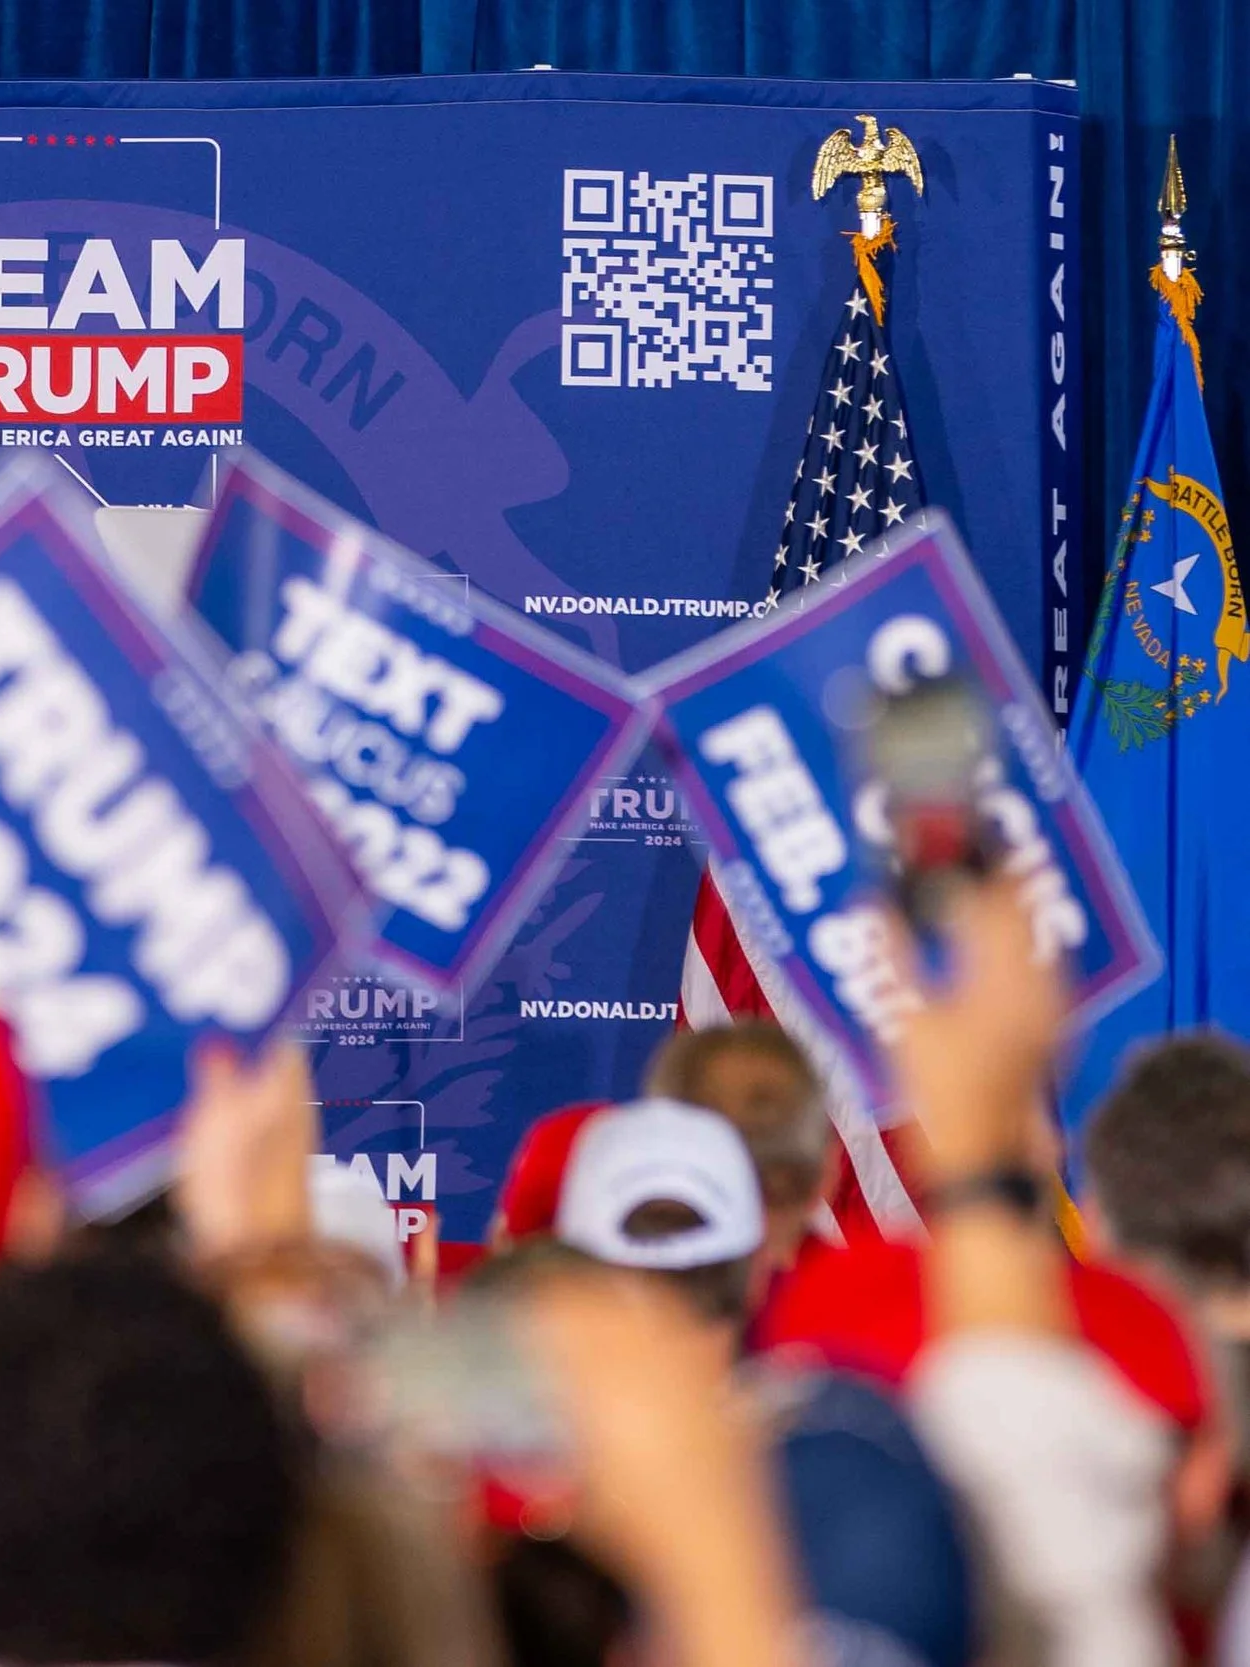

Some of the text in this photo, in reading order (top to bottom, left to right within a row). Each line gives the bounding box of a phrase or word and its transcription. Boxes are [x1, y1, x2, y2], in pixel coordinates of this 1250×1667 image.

[78, 429, 155, 447] GREAT
[161, 430, 244, 447] AGAIN!
[1171, 482, 1243, 619] BATTLE BORN
[525, 595, 768, 619] NV.DONALDJTRUMP.C
[1125, 579, 1172, 670] NEVADA
[273, 572, 507, 758] TEXT
[590, 788, 691, 820] TRU
[590, 822, 618, 831] MAKE
[621, 823, 665, 831] AMERICA
[644, 835, 683, 847] 2024
[307, 989, 440, 1019] RUMP
[520, 1000, 679, 1021] NV.DONALDJT
[314, 1023, 359, 1031] AMERICA
[361, 1022, 393, 1031] GREAT
[338, 1035, 375, 1046] 2024
